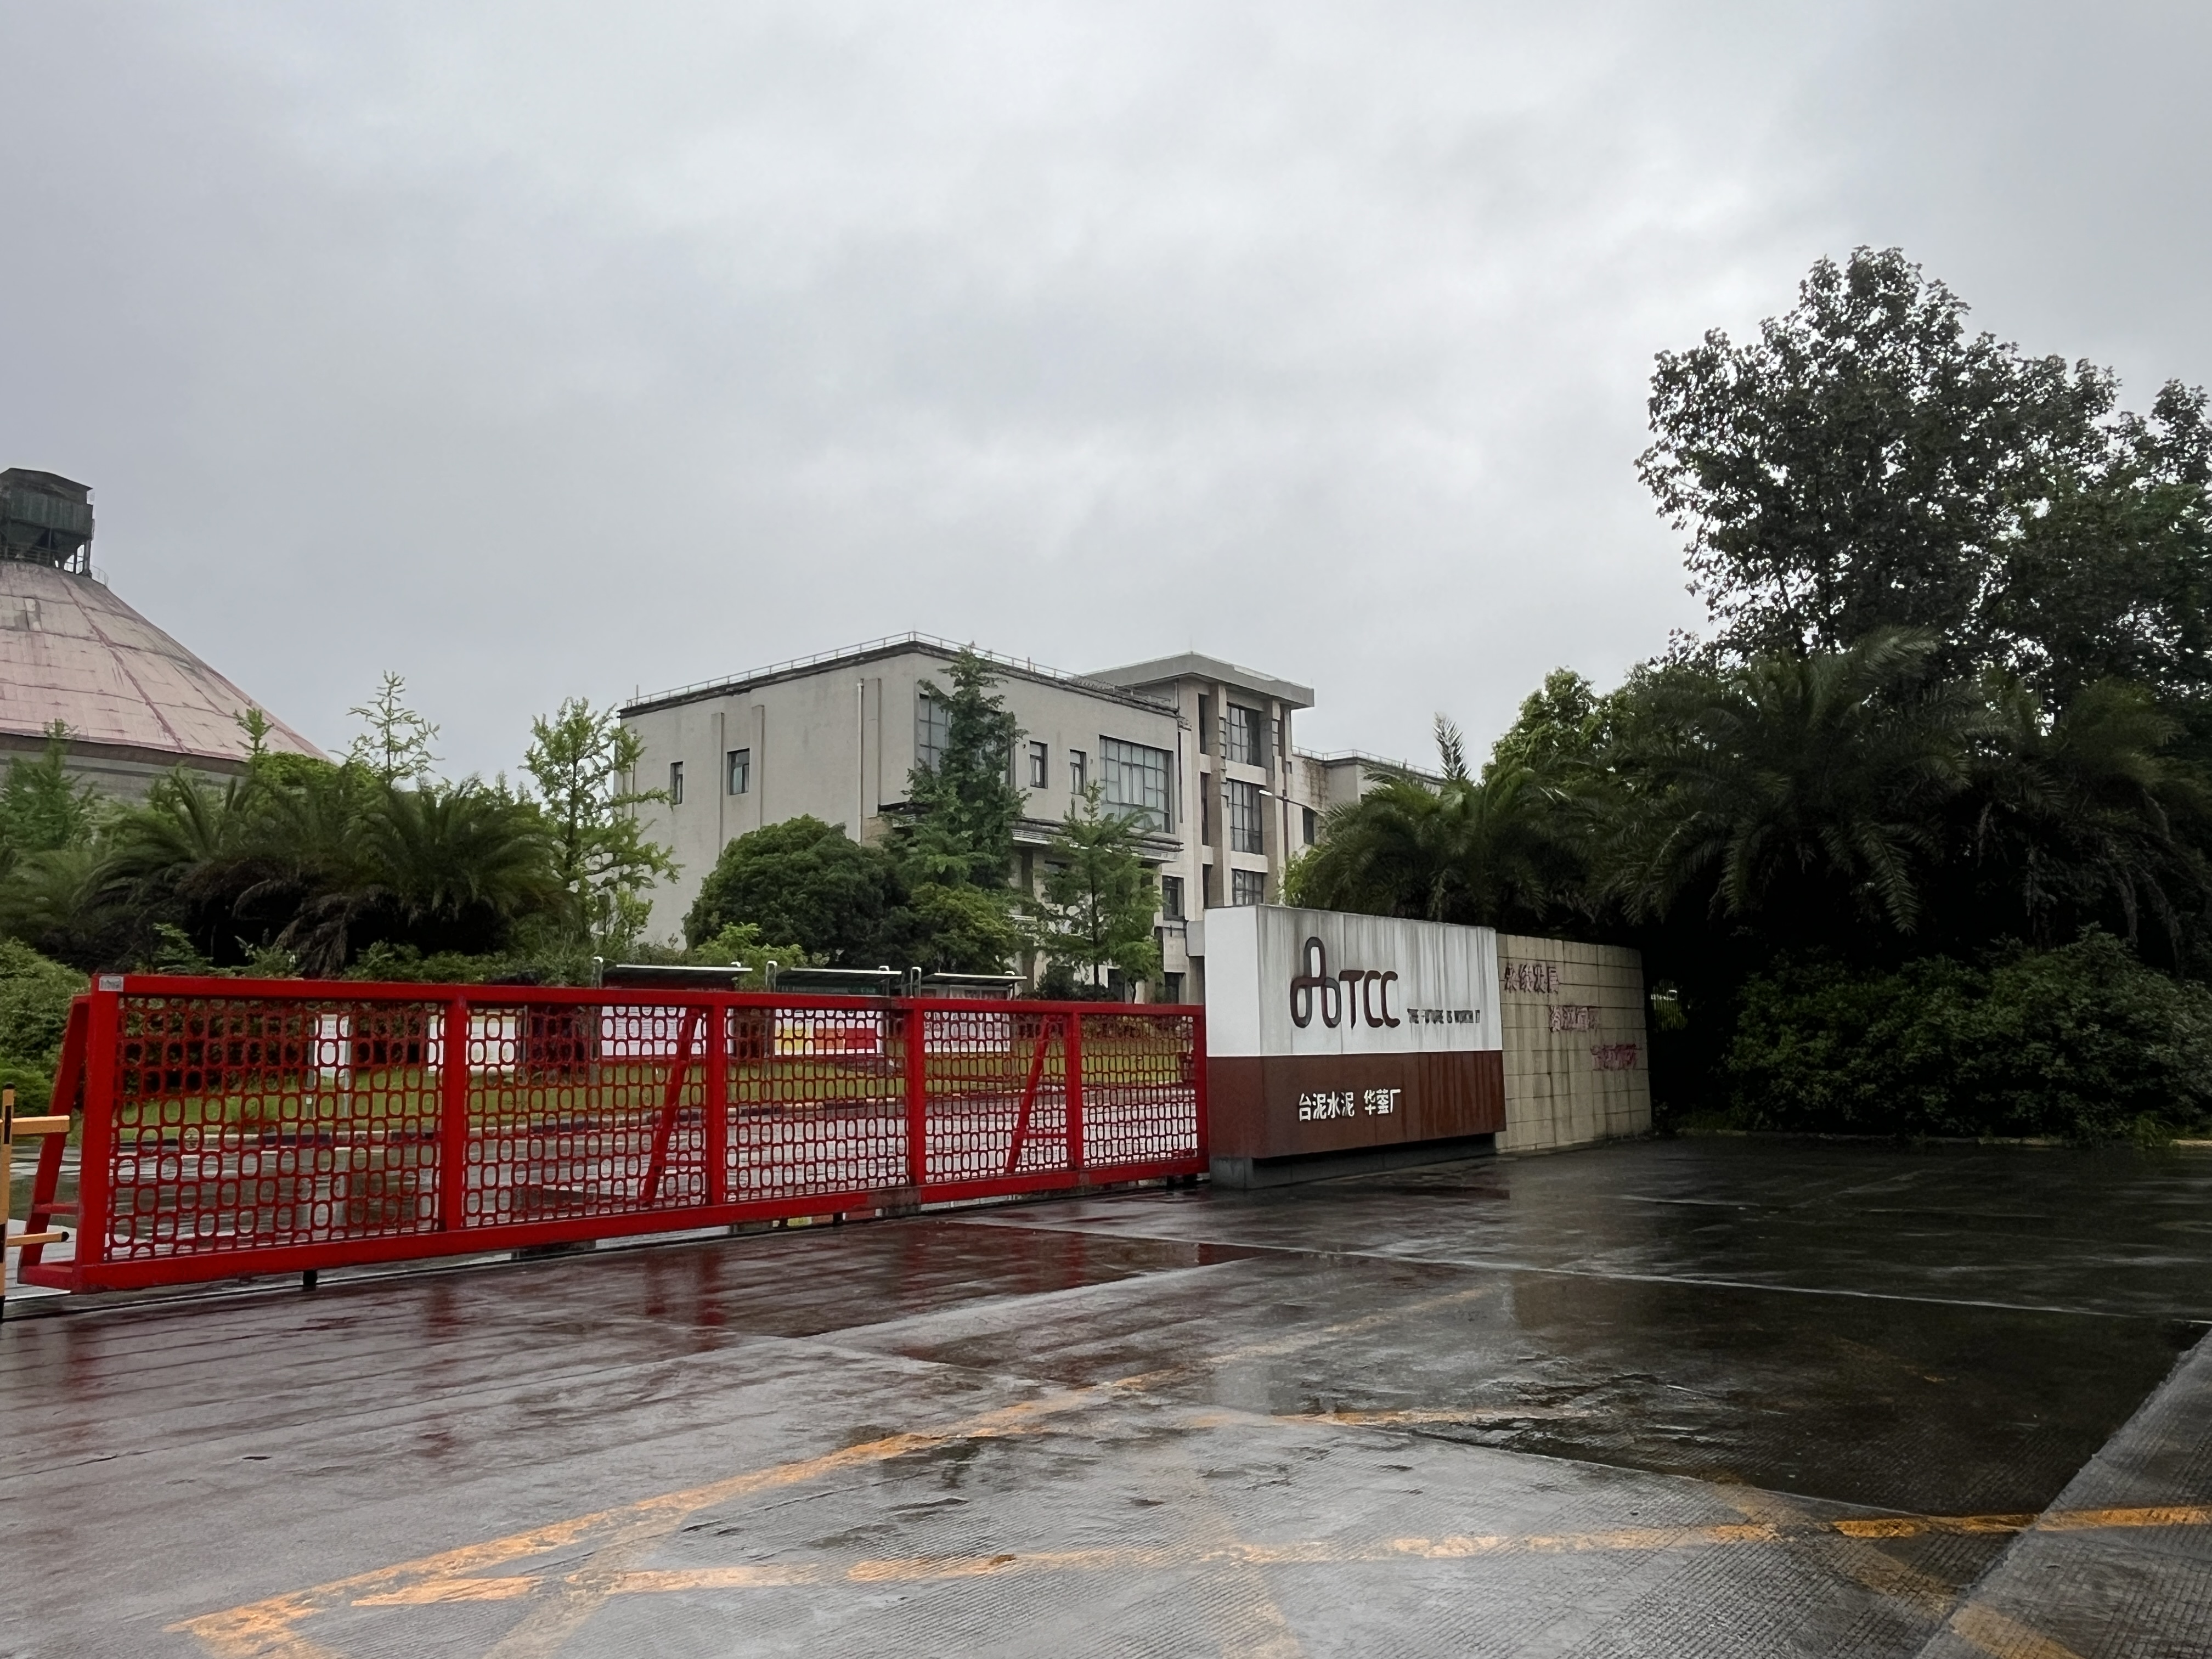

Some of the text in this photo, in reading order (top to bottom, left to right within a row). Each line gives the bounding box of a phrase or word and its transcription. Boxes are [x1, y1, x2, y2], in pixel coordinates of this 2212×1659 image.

[1339, 969, 1401, 1030] TCC
[1299, 1089, 1401, 1121] 台泥水泥 华蓥厂
